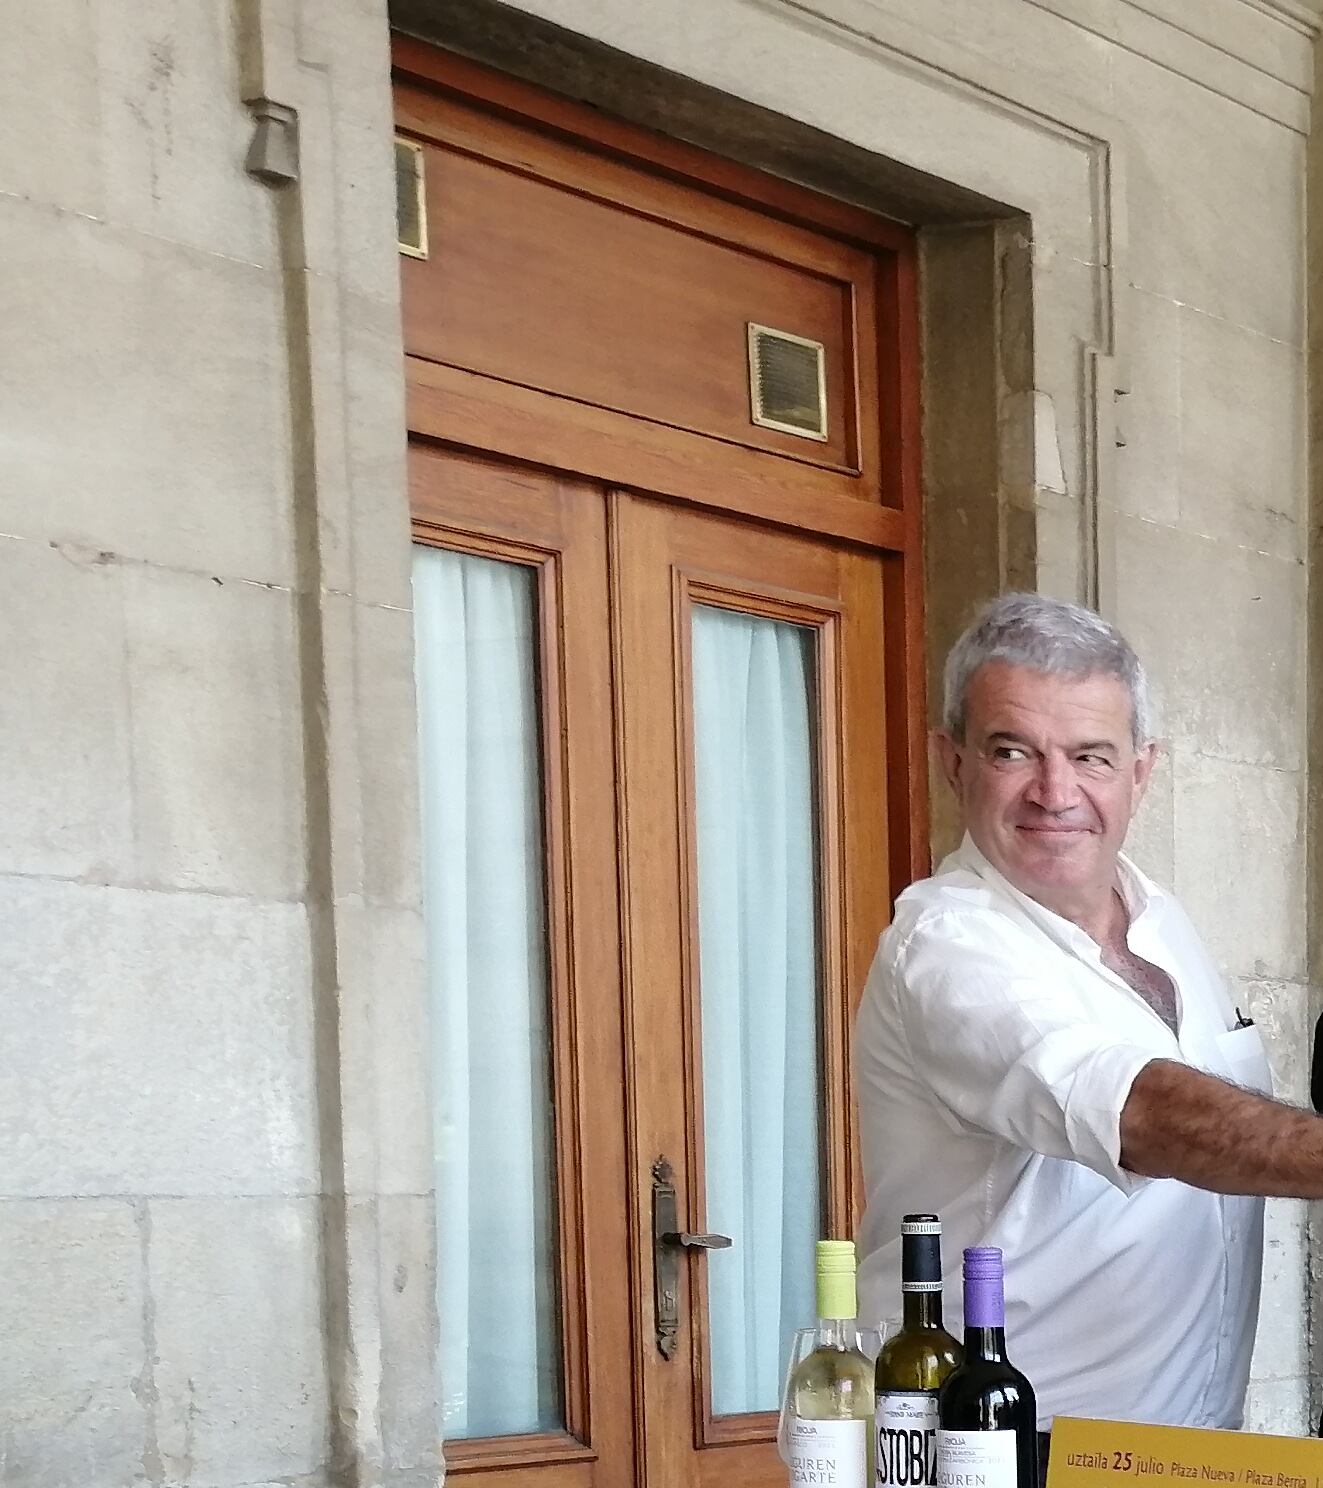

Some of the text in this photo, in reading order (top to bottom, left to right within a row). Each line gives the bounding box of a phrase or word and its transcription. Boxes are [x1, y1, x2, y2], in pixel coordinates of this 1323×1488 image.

[1067, 1452, 1109, 1470] uztaila
[1112, 1452, 1133, 1472] 25
[1136, 1456, 1164, 1478] julio
[1171, 1463, 1197, 1479] Plaza
[1202, 1466, 1235, 1483] Nueva
[1246, 1469, 1273, 1486] Plaza
